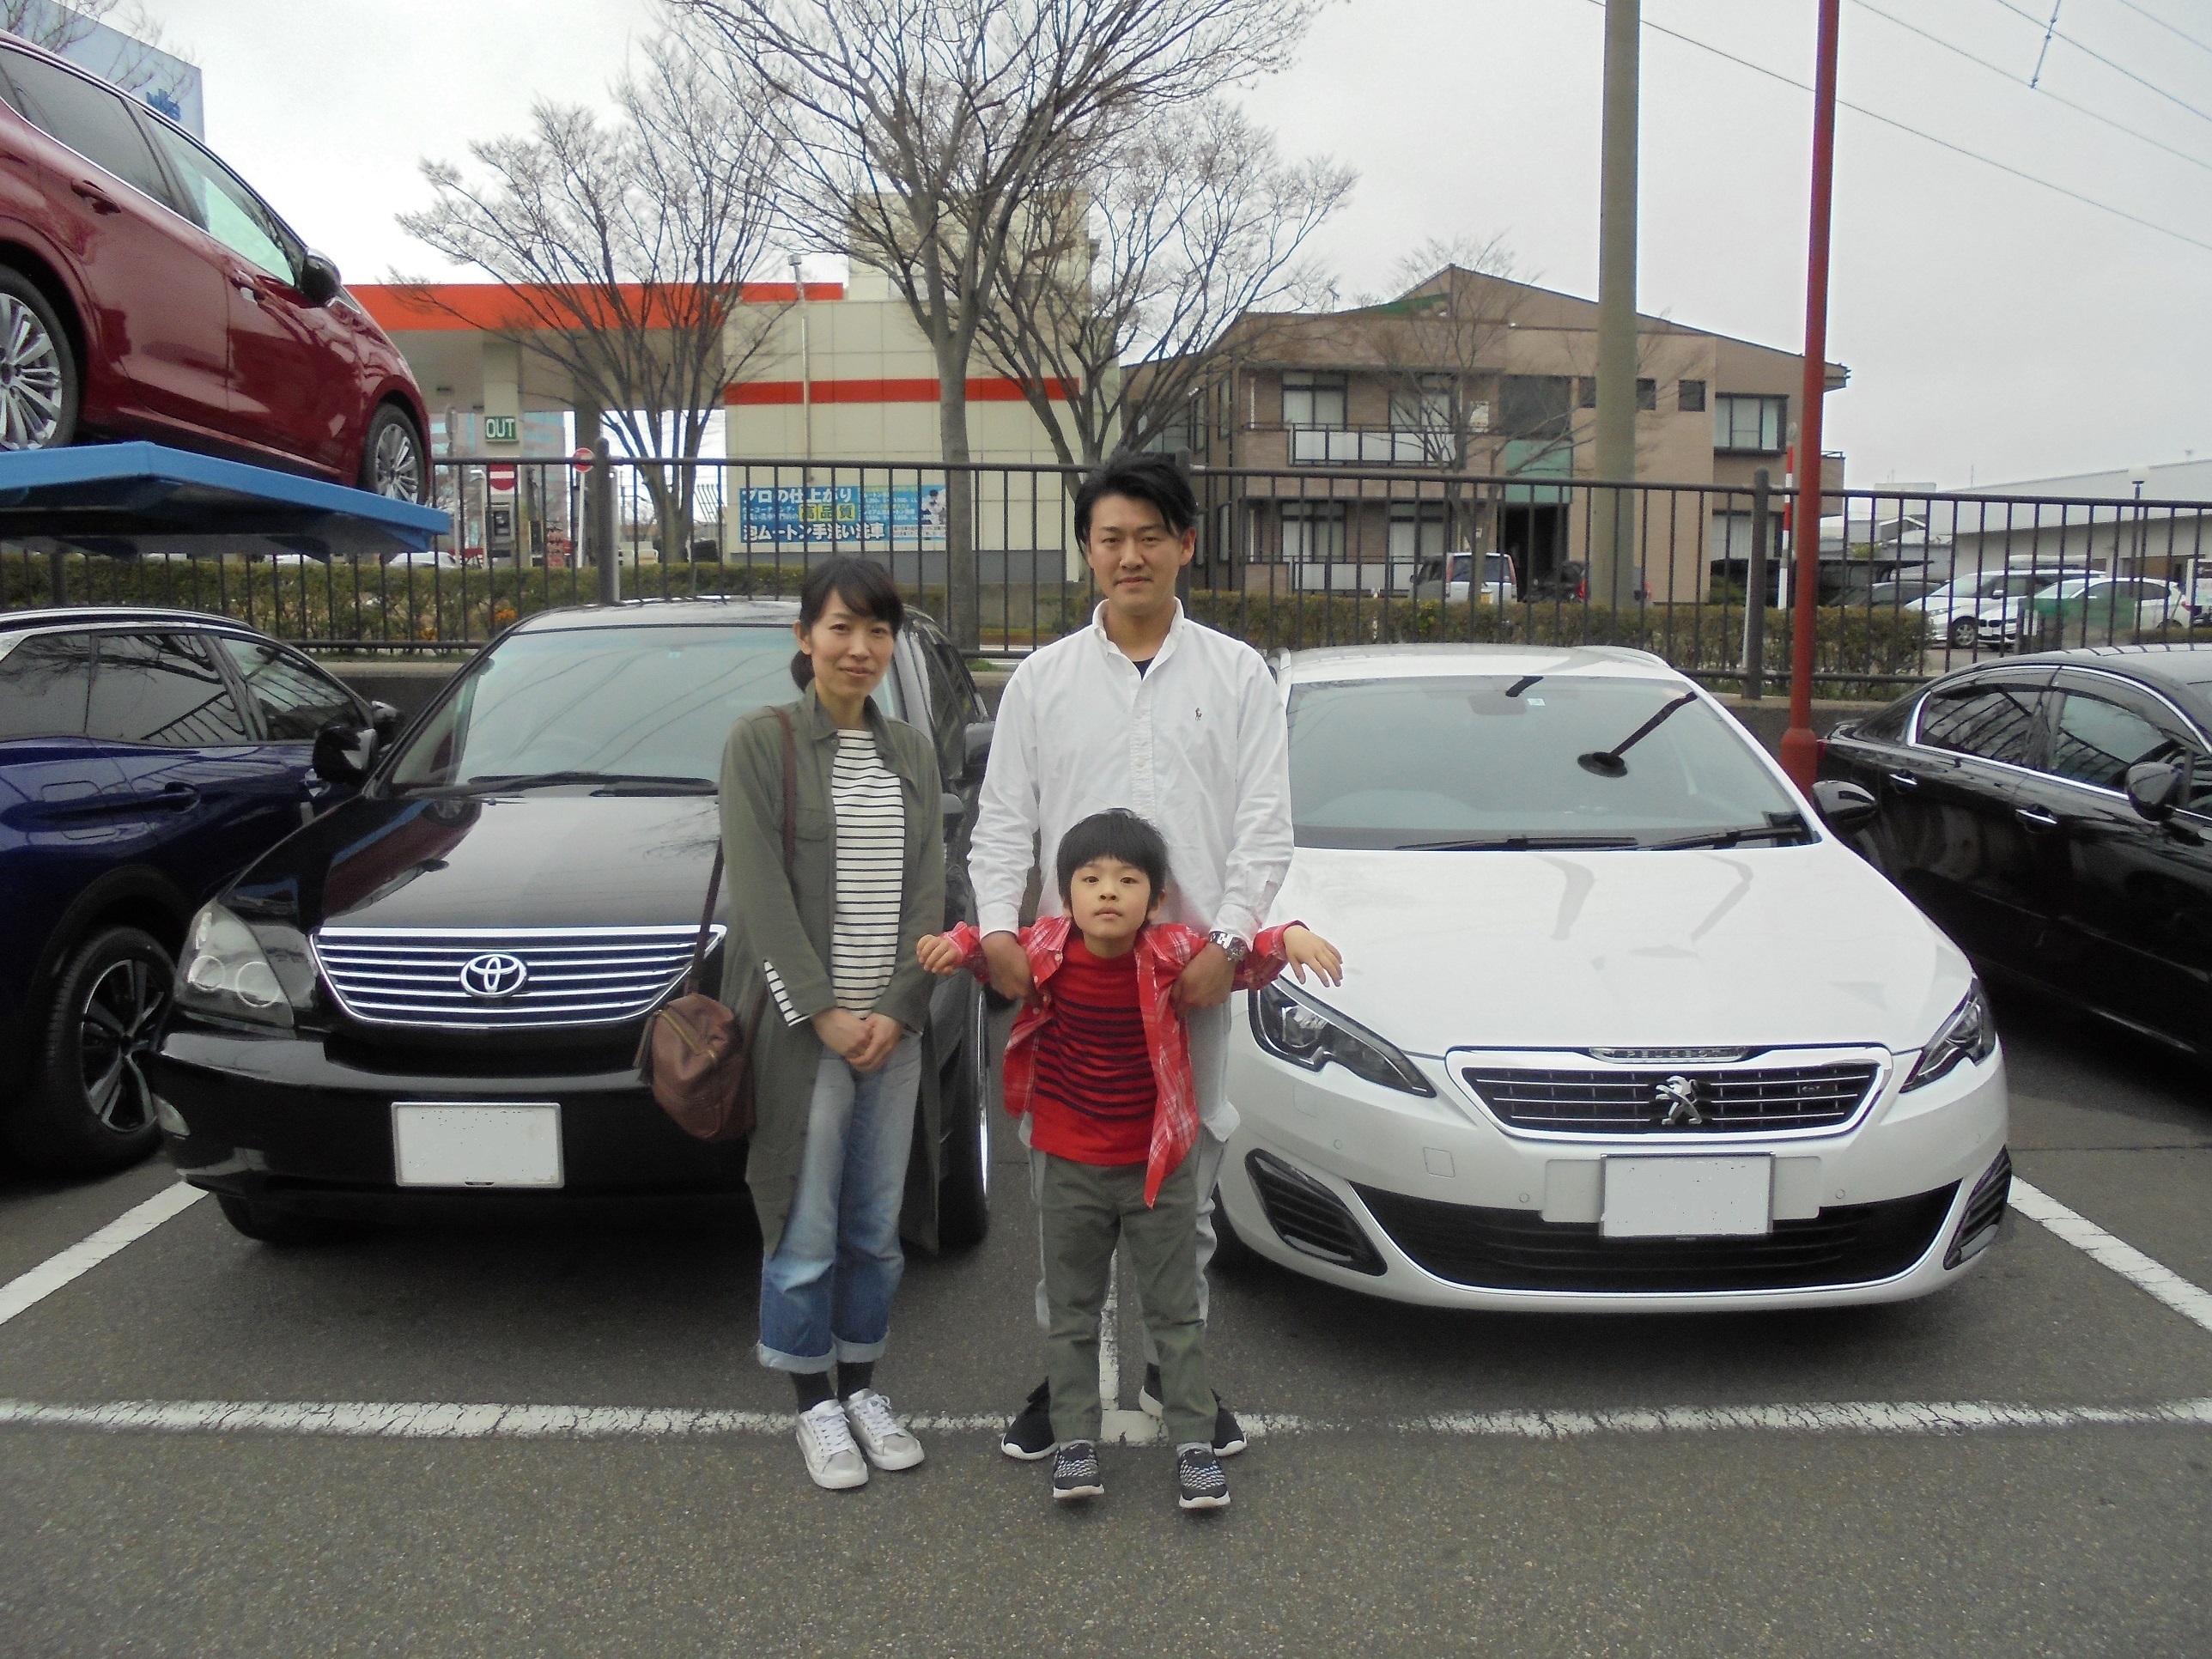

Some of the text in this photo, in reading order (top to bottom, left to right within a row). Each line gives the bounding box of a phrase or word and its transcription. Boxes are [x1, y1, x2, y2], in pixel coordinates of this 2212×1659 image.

[486, 418, 514, 438] OUT
[800, 504, 854, 520] 高品質
